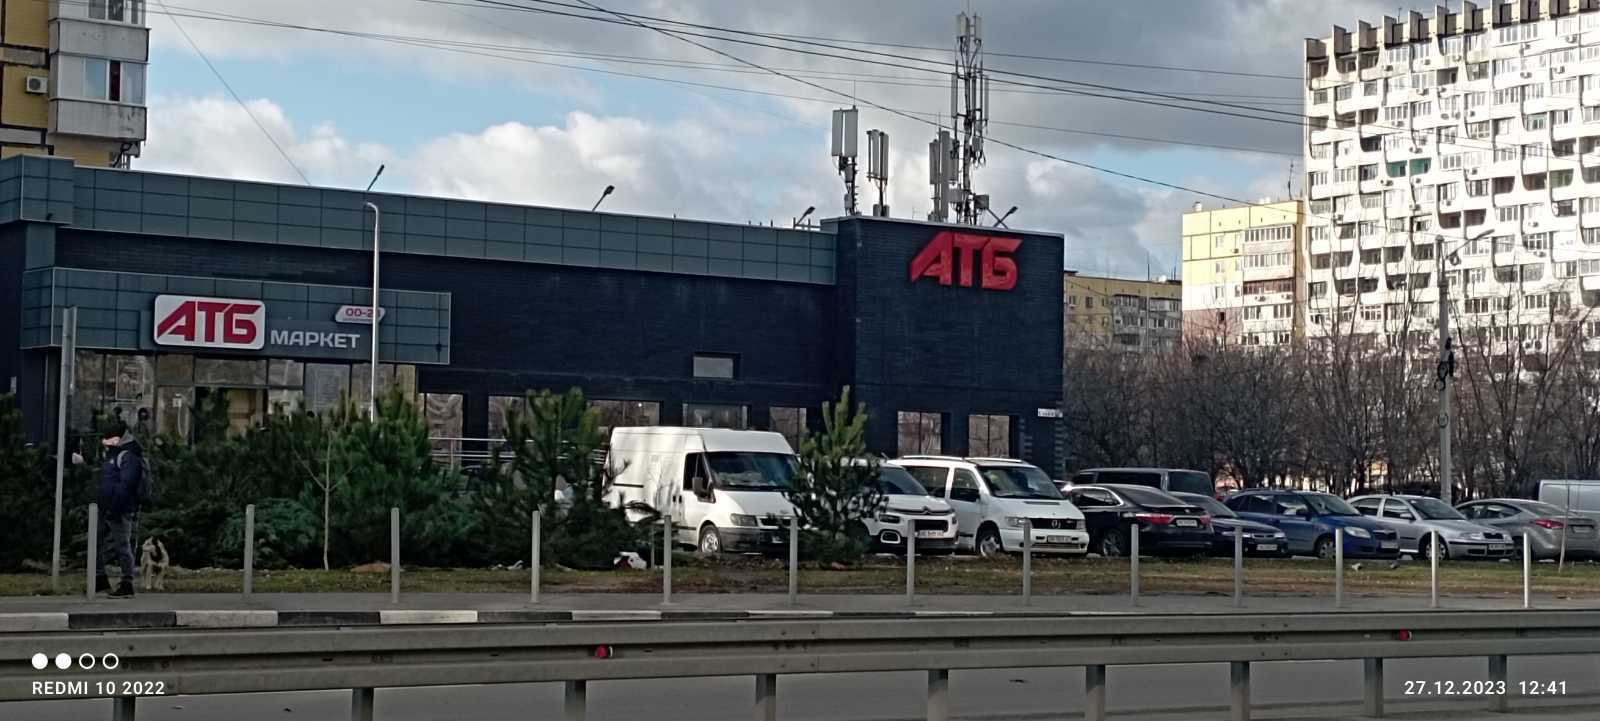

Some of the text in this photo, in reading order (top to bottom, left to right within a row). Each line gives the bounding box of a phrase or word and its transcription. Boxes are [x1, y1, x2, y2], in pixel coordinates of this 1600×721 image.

[910, 231, 1022, 291] АТБ
[157, 300, 262, 344] АТБ
[346, 307, 380, 318] 00-2
[270, 329, 361, 349] МАРКЕТ
